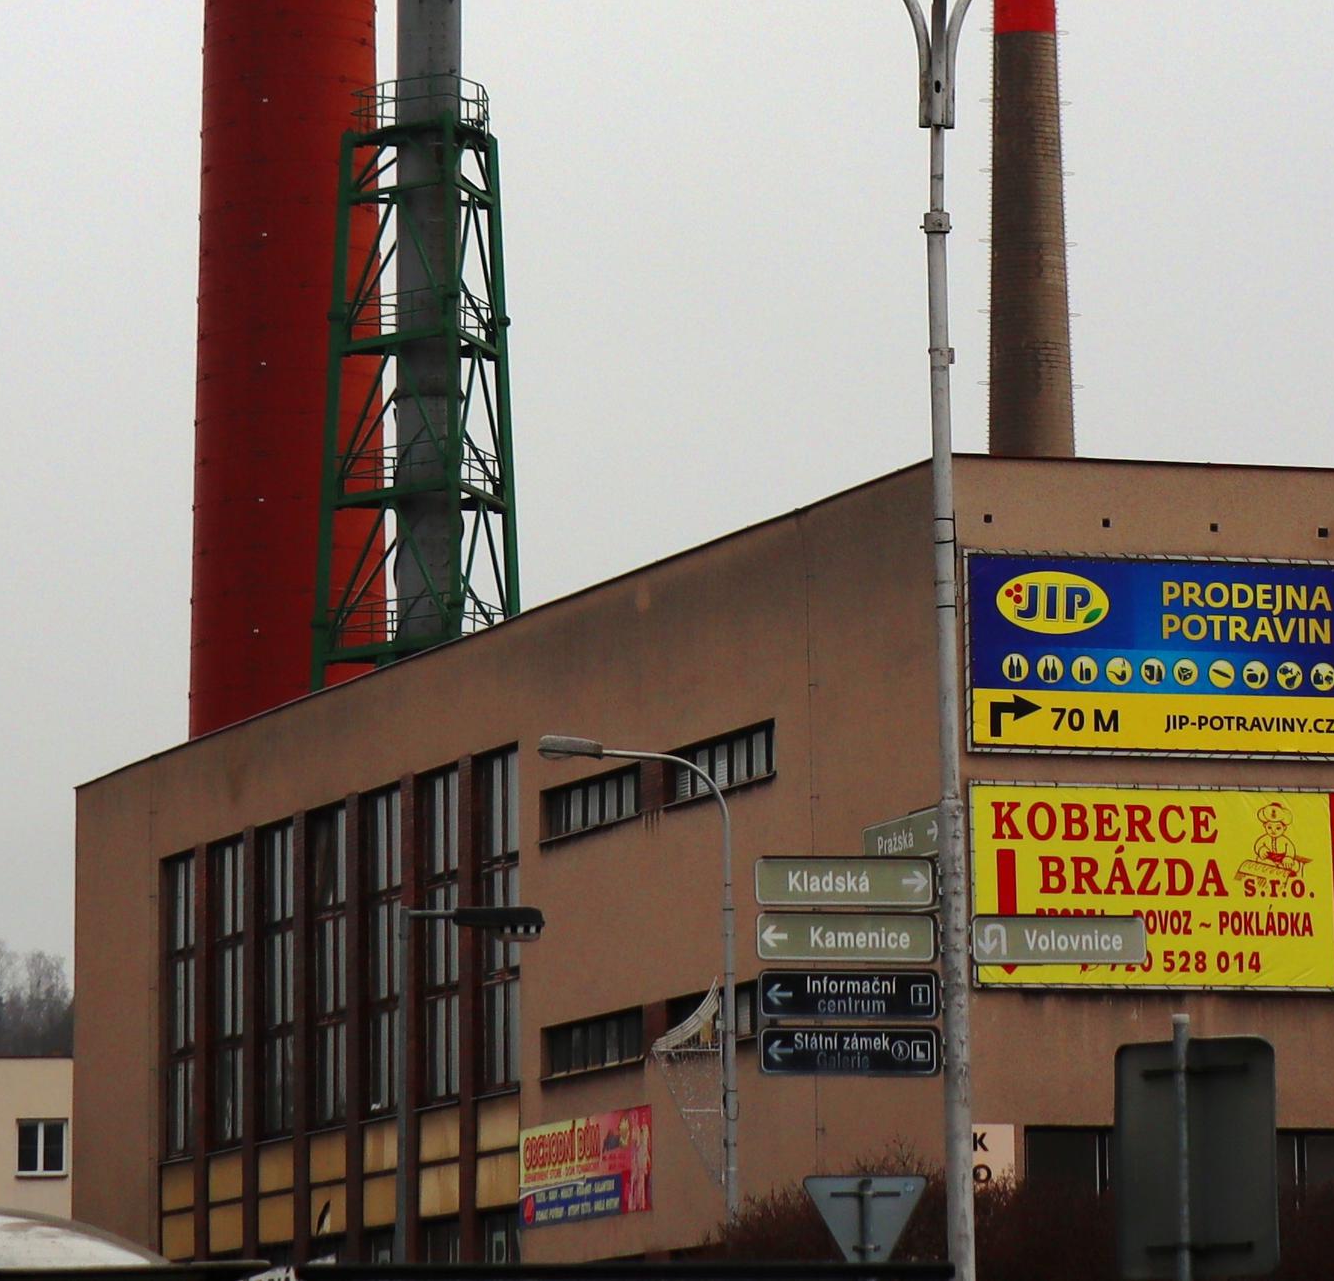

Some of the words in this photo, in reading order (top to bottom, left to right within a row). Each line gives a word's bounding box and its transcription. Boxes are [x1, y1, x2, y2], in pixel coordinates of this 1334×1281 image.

[1016, 583, 1092, 622] JIP
[1162, 582, 1332, 615] PRODEJNA
[1162, 615, 1331, 644] POTRAVIN
[1051, 707, 1084, 731] 70
[1094, 709, 1119, 732] M
[991, 802, 1219, 843] KOBERCE
[877, 830, 914, 856] Pražská
[788, 871, 870, 893] Kladská
[1039, 845, 1228, 897] BRÁZDA
[1244, 877, 1315, 899] s.r.o.
[1219, 905, 1313, 937] POKLÁDKA
[810, 926, 910, 949] Kamenice
[1025, 929, 1123, 951] Volovnice
[1163, 951, 1207, 973] 528
[1217, 951, 1261, 973] 014
[806, 975, 896, 995] Informační
[818, 997, 886, 1013] centrum
[794, 1032, 838, 1051] Státní
[843, 1032, 890, 1051] zámek
[524, 1119, 575, 1170] OBCHODNÍ
